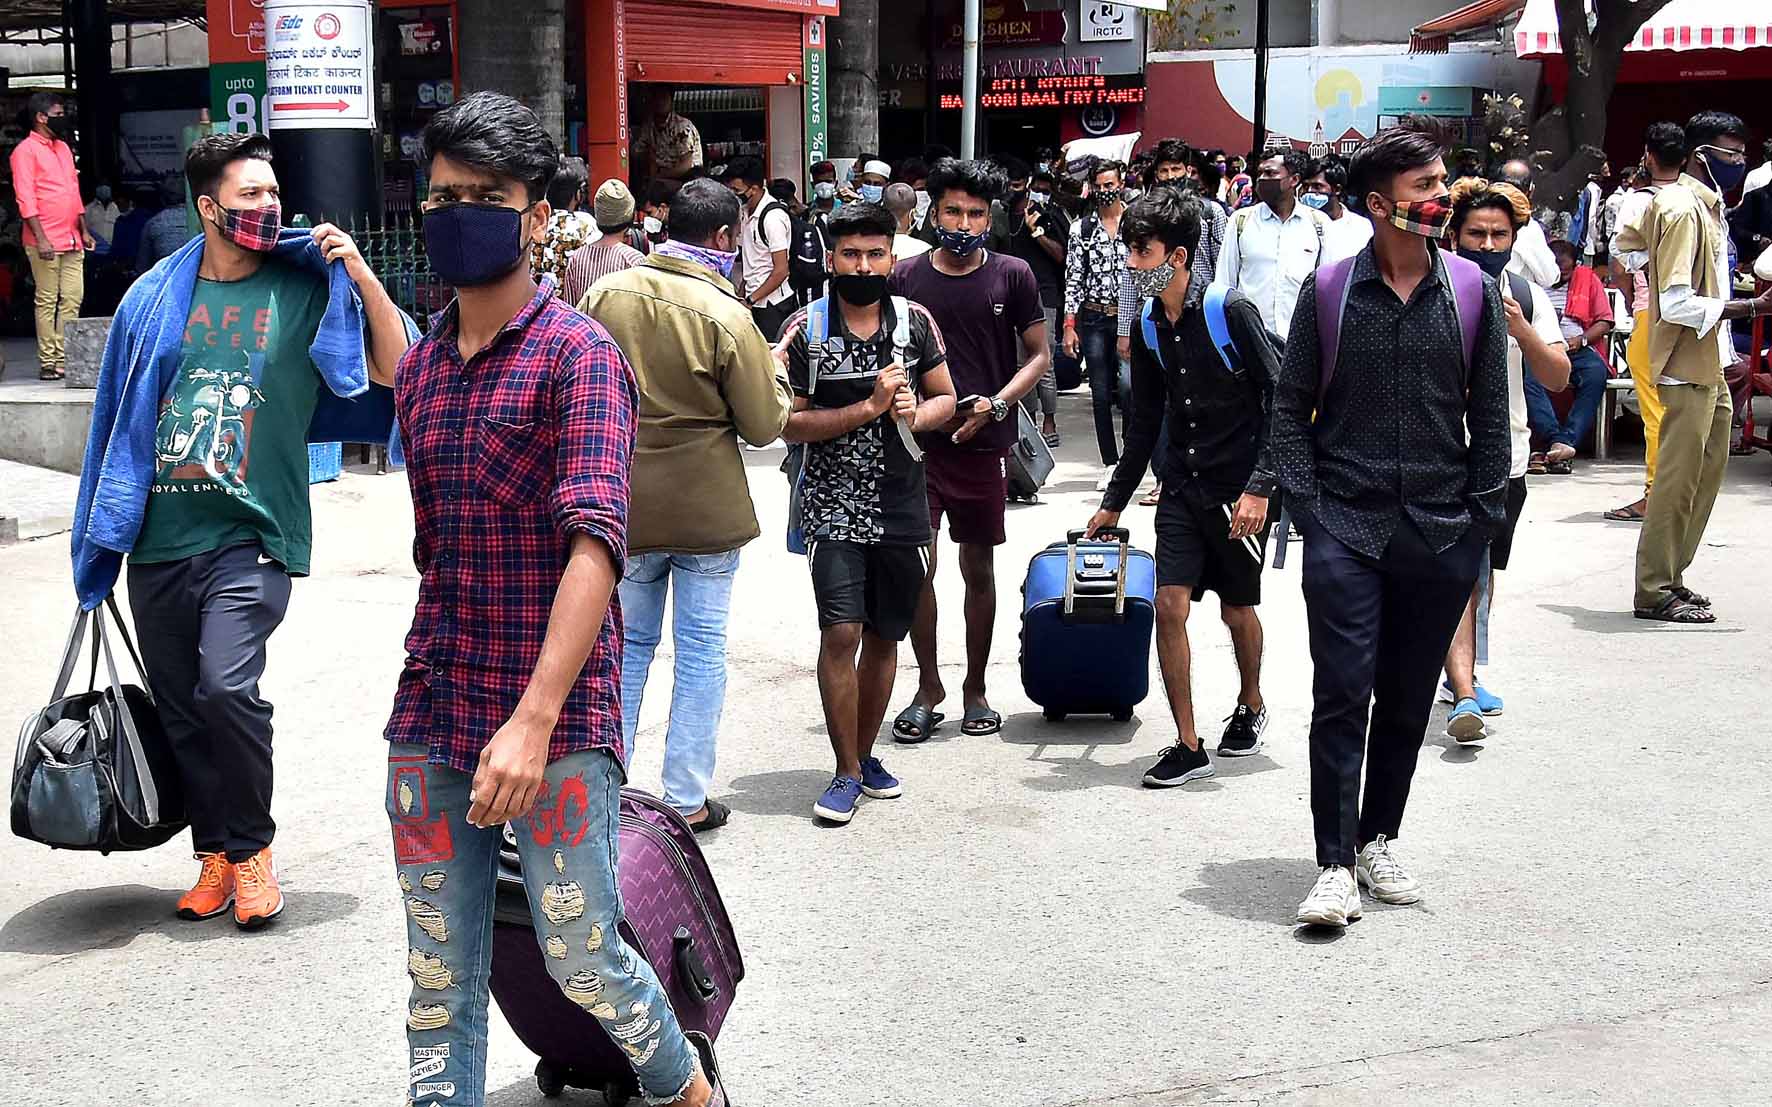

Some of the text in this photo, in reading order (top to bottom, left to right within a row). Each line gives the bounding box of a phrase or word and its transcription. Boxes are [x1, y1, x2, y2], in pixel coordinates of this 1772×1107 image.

[1093, 27, 1122, 36] IRCTC
[225, 78, 255, 91] upto
[294, 86, 322, 96] TICKET
[325, 84, 363, 95] COUNTER
[811, 53, 821, 124] SAVINGS
[226, 93, 270, 137] 8
[417, 1082, 452, 1092] YOUNGER
